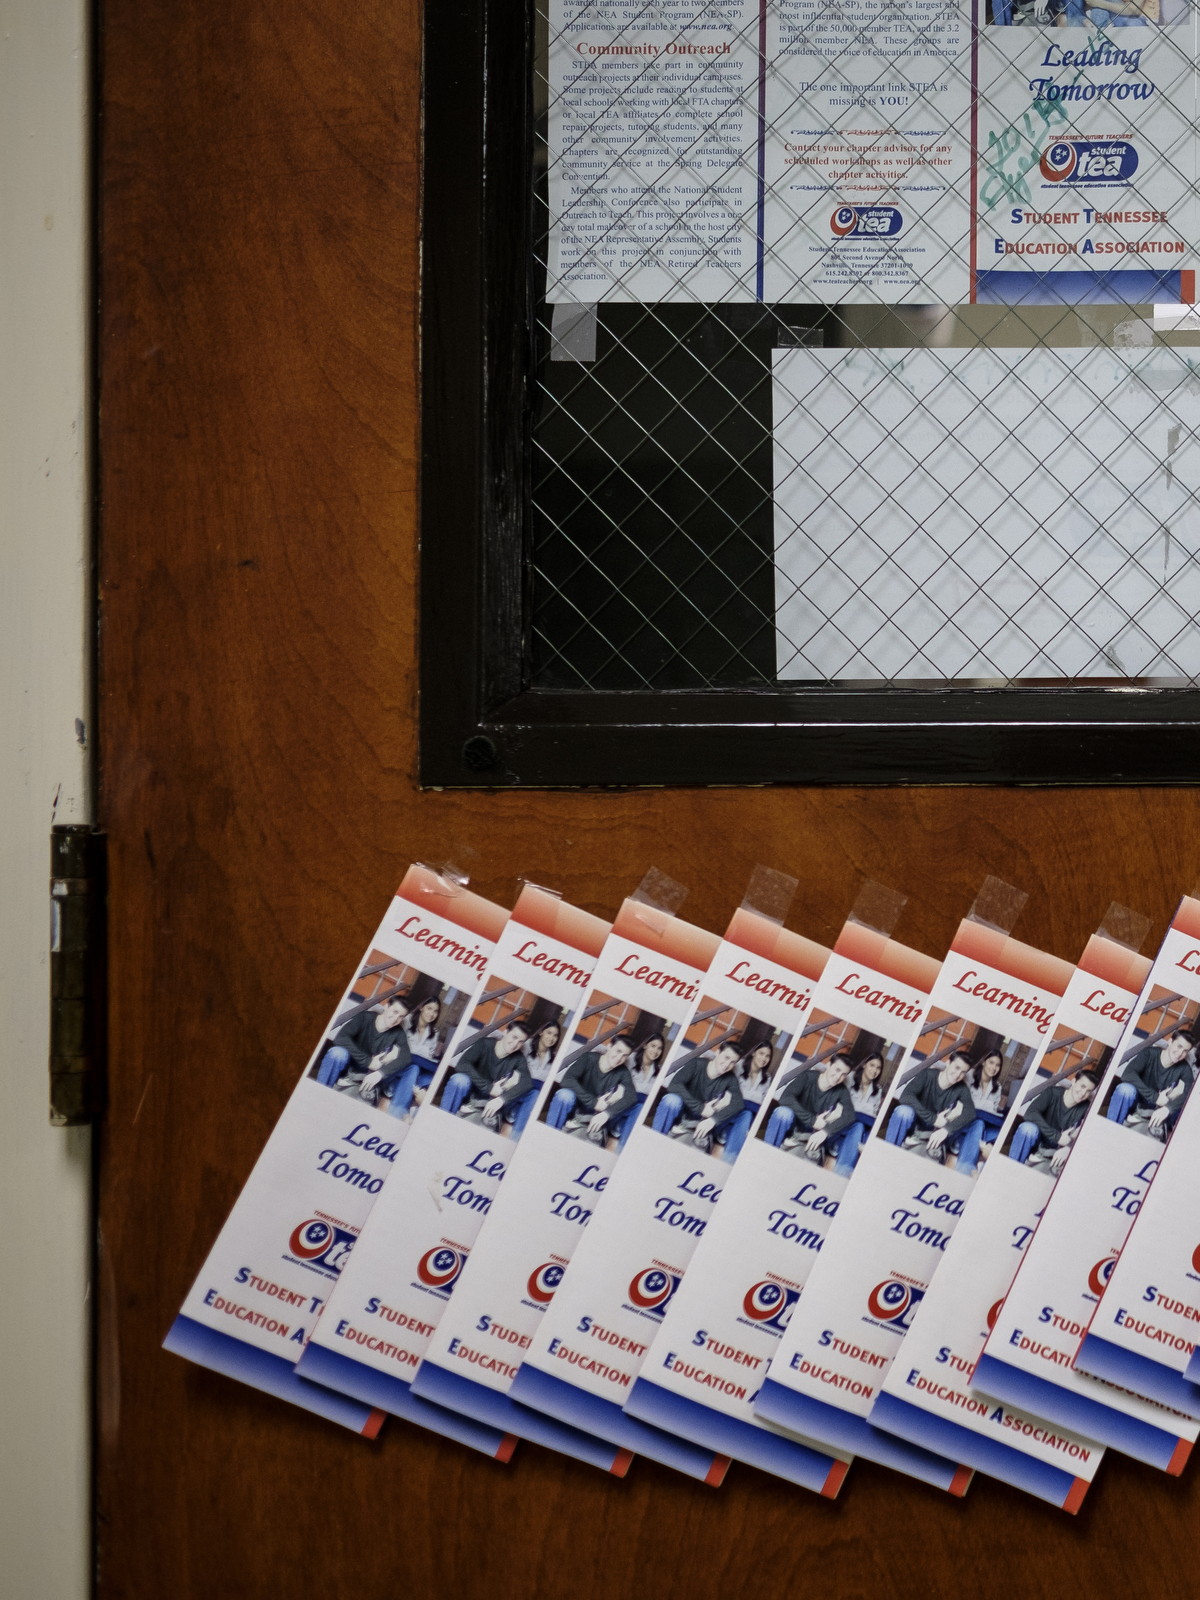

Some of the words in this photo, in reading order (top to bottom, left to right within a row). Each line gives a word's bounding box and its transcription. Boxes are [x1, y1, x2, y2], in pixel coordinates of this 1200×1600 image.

[780, 24, 786, 32] is
[806, 24, 814, 32] of
[816, 24, 828, 32] the
[831, 24, 857, 33] 50,000
[894, 24, 915, 33] TEA,
[917, 24, 931, 32] and
[933, 24, 945, 32] the
[947, 24, 959, 32] 3.2
[577, 42, 660, 57] Community
[666, 42, 731, 54] Outreach
[1041, 43, 1142, 73] Leading
[800, 82, 817, 92] The
[820, 84, 837, 92] one
[840, 82, 886, 95] important
[888, 82, 906, 92] link
[909, 83, 937, 92] STEA
[940, 83, 947, 91] is
[1029, 77, 1155, 101] Tomorrow
[830, 97, 866, 107] missing
[869, 97, 877, 105] is
[880, 97, 909, 105] YOU!
[784, 143, 820, 152] Contact
[823, 145, 844, 155] your
[847, 143, 881, 155] chapter
[884, 143, 917, 152] advisor
[920, 143, 934, 152] for
[936, 145, 952, 155] any
[1091, 146, 1126, 156] student
[784, 157, 829, 165] scheduled
[832, 157, 881, 168] workshops
[896, 157, 914, 165] well
[929, 157, 952, 165] other
[829, 170, 863, 181] chapter
[866, 170, 908, 179] activities.
[1077, 152, 1122, 178] tea
[858, 217, 890, 232] tea
[868, 210, 894, 218] student
[1011, 209, 1080, 225] STUDENT
[1083, 209, 1168, 224] TENNESSEE
[994, 239, 1078, 255] EDUCATION
[1082, 239, 1184, 254] ASSOCIATION
[234, 1267, 307, 1308] STUDENT
[203, 1289, 289, 1338] EDUCATION
[365, 1297, 435, 1338] STUDENT
[334, 1320, 419, 1367] EDUCATION
[576, 1316, 648, 1357] STUDENT
[1113, 1308, 1196, 1355] EDUCATION
[547, 1337, 631, 1387] EDUCATION
[692, 1330, 763, 1370] STUDENT
[818, 1330, 888, 1369] STUDENT
[663, 1352, 748, 1400] EDUCATION
[789, 1353, 873, 1400] EDUCATION
[906, 1369, 988, 1417] EDUCATION
[989, 1407, 1090, 1463] ASSOCIATION
